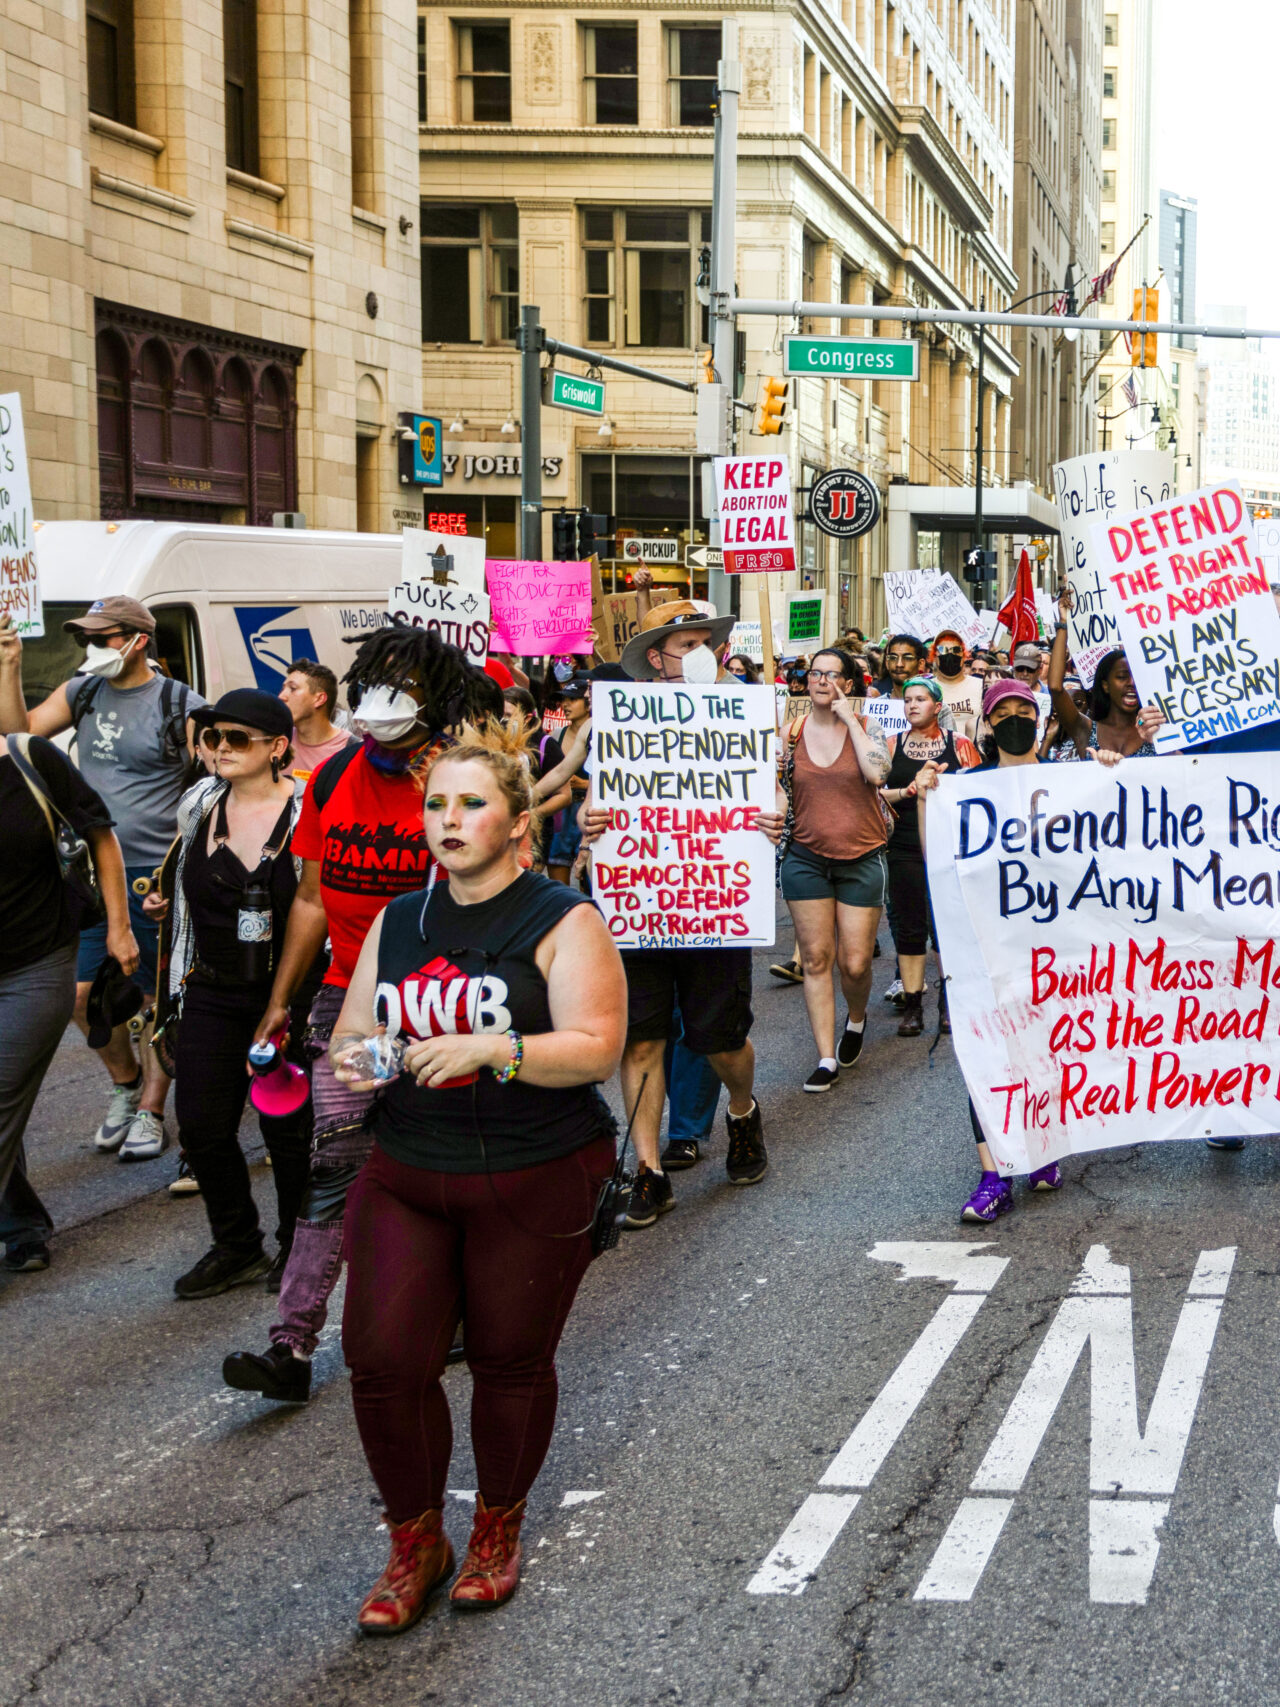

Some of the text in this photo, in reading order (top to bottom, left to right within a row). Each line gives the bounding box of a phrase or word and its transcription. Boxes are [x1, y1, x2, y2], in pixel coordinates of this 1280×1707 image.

[807, 347, 895, 369] Congress
[562, 383, 596, 405] Griswold
[724, 461, 783, 490] KEEP
[816, 477, 870, 500] JIMMY JOHN'S
[722, 494, 787, 511] ABORTION
[829, 490, 858, 519] JJ
[1134, 479, 1153, 507] is
[428, 513, 467, 526] FREE
[429, 524, 467, 535] SMELLS
[724, 516, 788, 543] LEGAL
[1108, 488, 1243, 563] DEFEND
[643, 543, 676, 558] PICKUP
[707, 553, 722, 561] ONE
[1, 552, 37, 586] MEANS
[495, 564, 555, 577] FIGHT FOR
[1110, 535, 1251, 601] THE RIGHT
[1066, 570, 1108, 619] Don't
[1125, 557, 1270, 629] TO ABORTION
[340, 610, 358, 629] We
[549, 604, 577, 618] WITH
[1140, 608, 1238, 664] BY ANY
[1165, 638, 1258, 692] MEANS
[1147, 658, 1280, 725] NECESSARY
[609, 689, 746, 724] BUILD THE
[869, 704, 889, 714] KEEP
[1182, 701, 1280, 743] BAMN.COM
[598, 727, 775, 763] INDEPENDENT
[599, 767, 757, 801] MOVEMENT
[601, 805, 762, 834] NO RELIANCE
[954, 781, 1127, 861] Defend
[1142, 785, 1206, 850] the
[326, 838, 429, 871] BAMN
[617, 832, 724, 860] ON THE
[595, 860, 751, 890] DEMOCRATS
[998, 859, 1059, 924] By
[1067, 855, 1162, 924] Any
[603, 888, 750, 912] TO DEFEND
[608, 913, 750, 937] OUR RIGHTS
[638, 935, 722, 949] BAMN.COM
[1031, 942, 1115, 1006] Build
[1125, 935, 1215, 994] Mass
[1049, 1009, 1097, 1054] as
[1106, 999, 1164, 1051] the
[1172, 995, 1270, 1045] Road
[990, 1078, 1051, 1135] The
[1059, 1056, 1137, 1125] Real
[1147, 1051, 1272, 1113] Power
